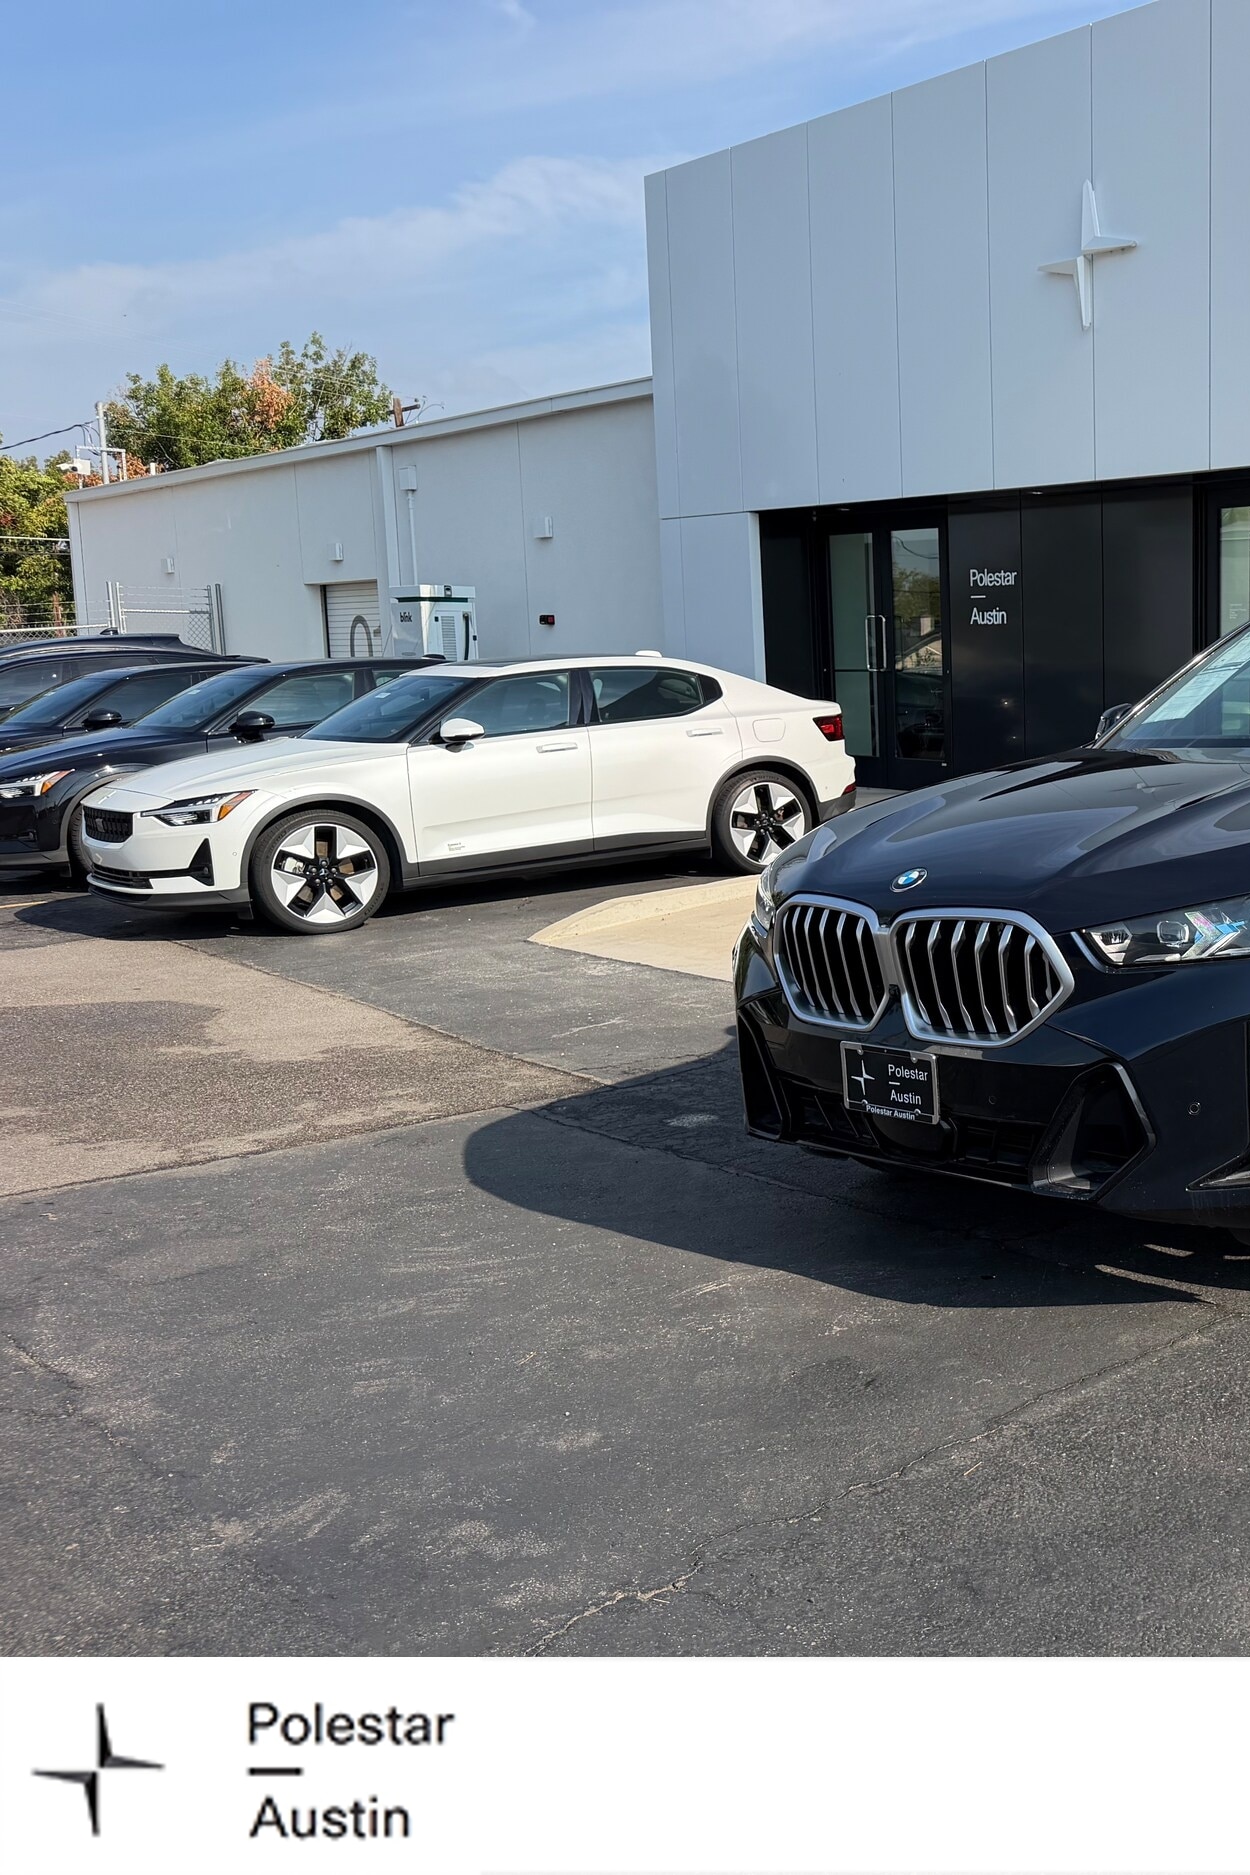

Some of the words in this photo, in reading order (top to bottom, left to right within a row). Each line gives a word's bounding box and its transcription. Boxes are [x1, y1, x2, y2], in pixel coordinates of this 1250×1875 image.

[969, 568, 1017, 587] Polestar
[970, 607, 1007, 625] Austin
[888, 1064, 928, 1081] Polestar
[890, 1089, 922, 1105] Austin
[866, 1105, 892, 1117] Polestar
[894, 1110, 916, 1120] Austin
